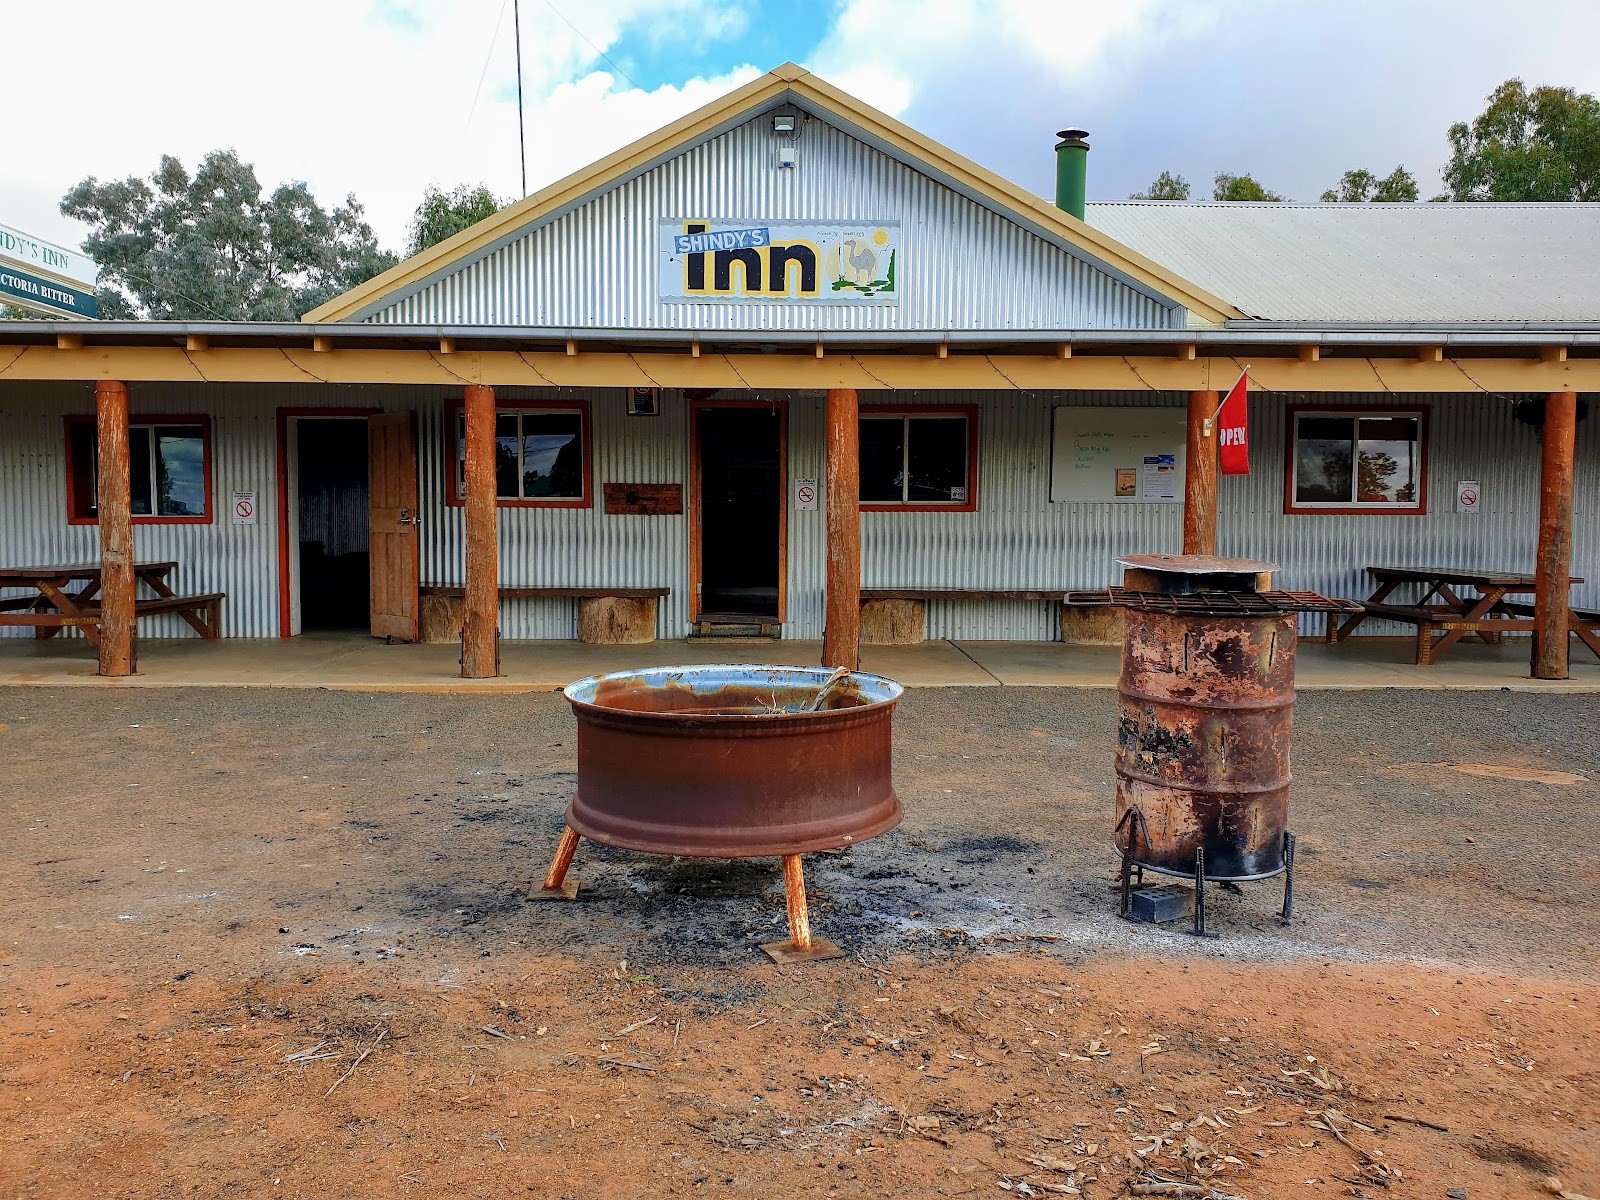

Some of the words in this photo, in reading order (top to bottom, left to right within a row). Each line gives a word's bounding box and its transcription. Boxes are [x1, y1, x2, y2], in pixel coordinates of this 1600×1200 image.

[0, 231, 38, 258] DY'S
[42, 246, 69, 269] INN
[678, 229, 765, 252] SHINDY'S
[0, 272, 39, 294] CTORIA
[41, 285, 75, 306] BITTER
[1220, 426, 1245, 446] OPEN
